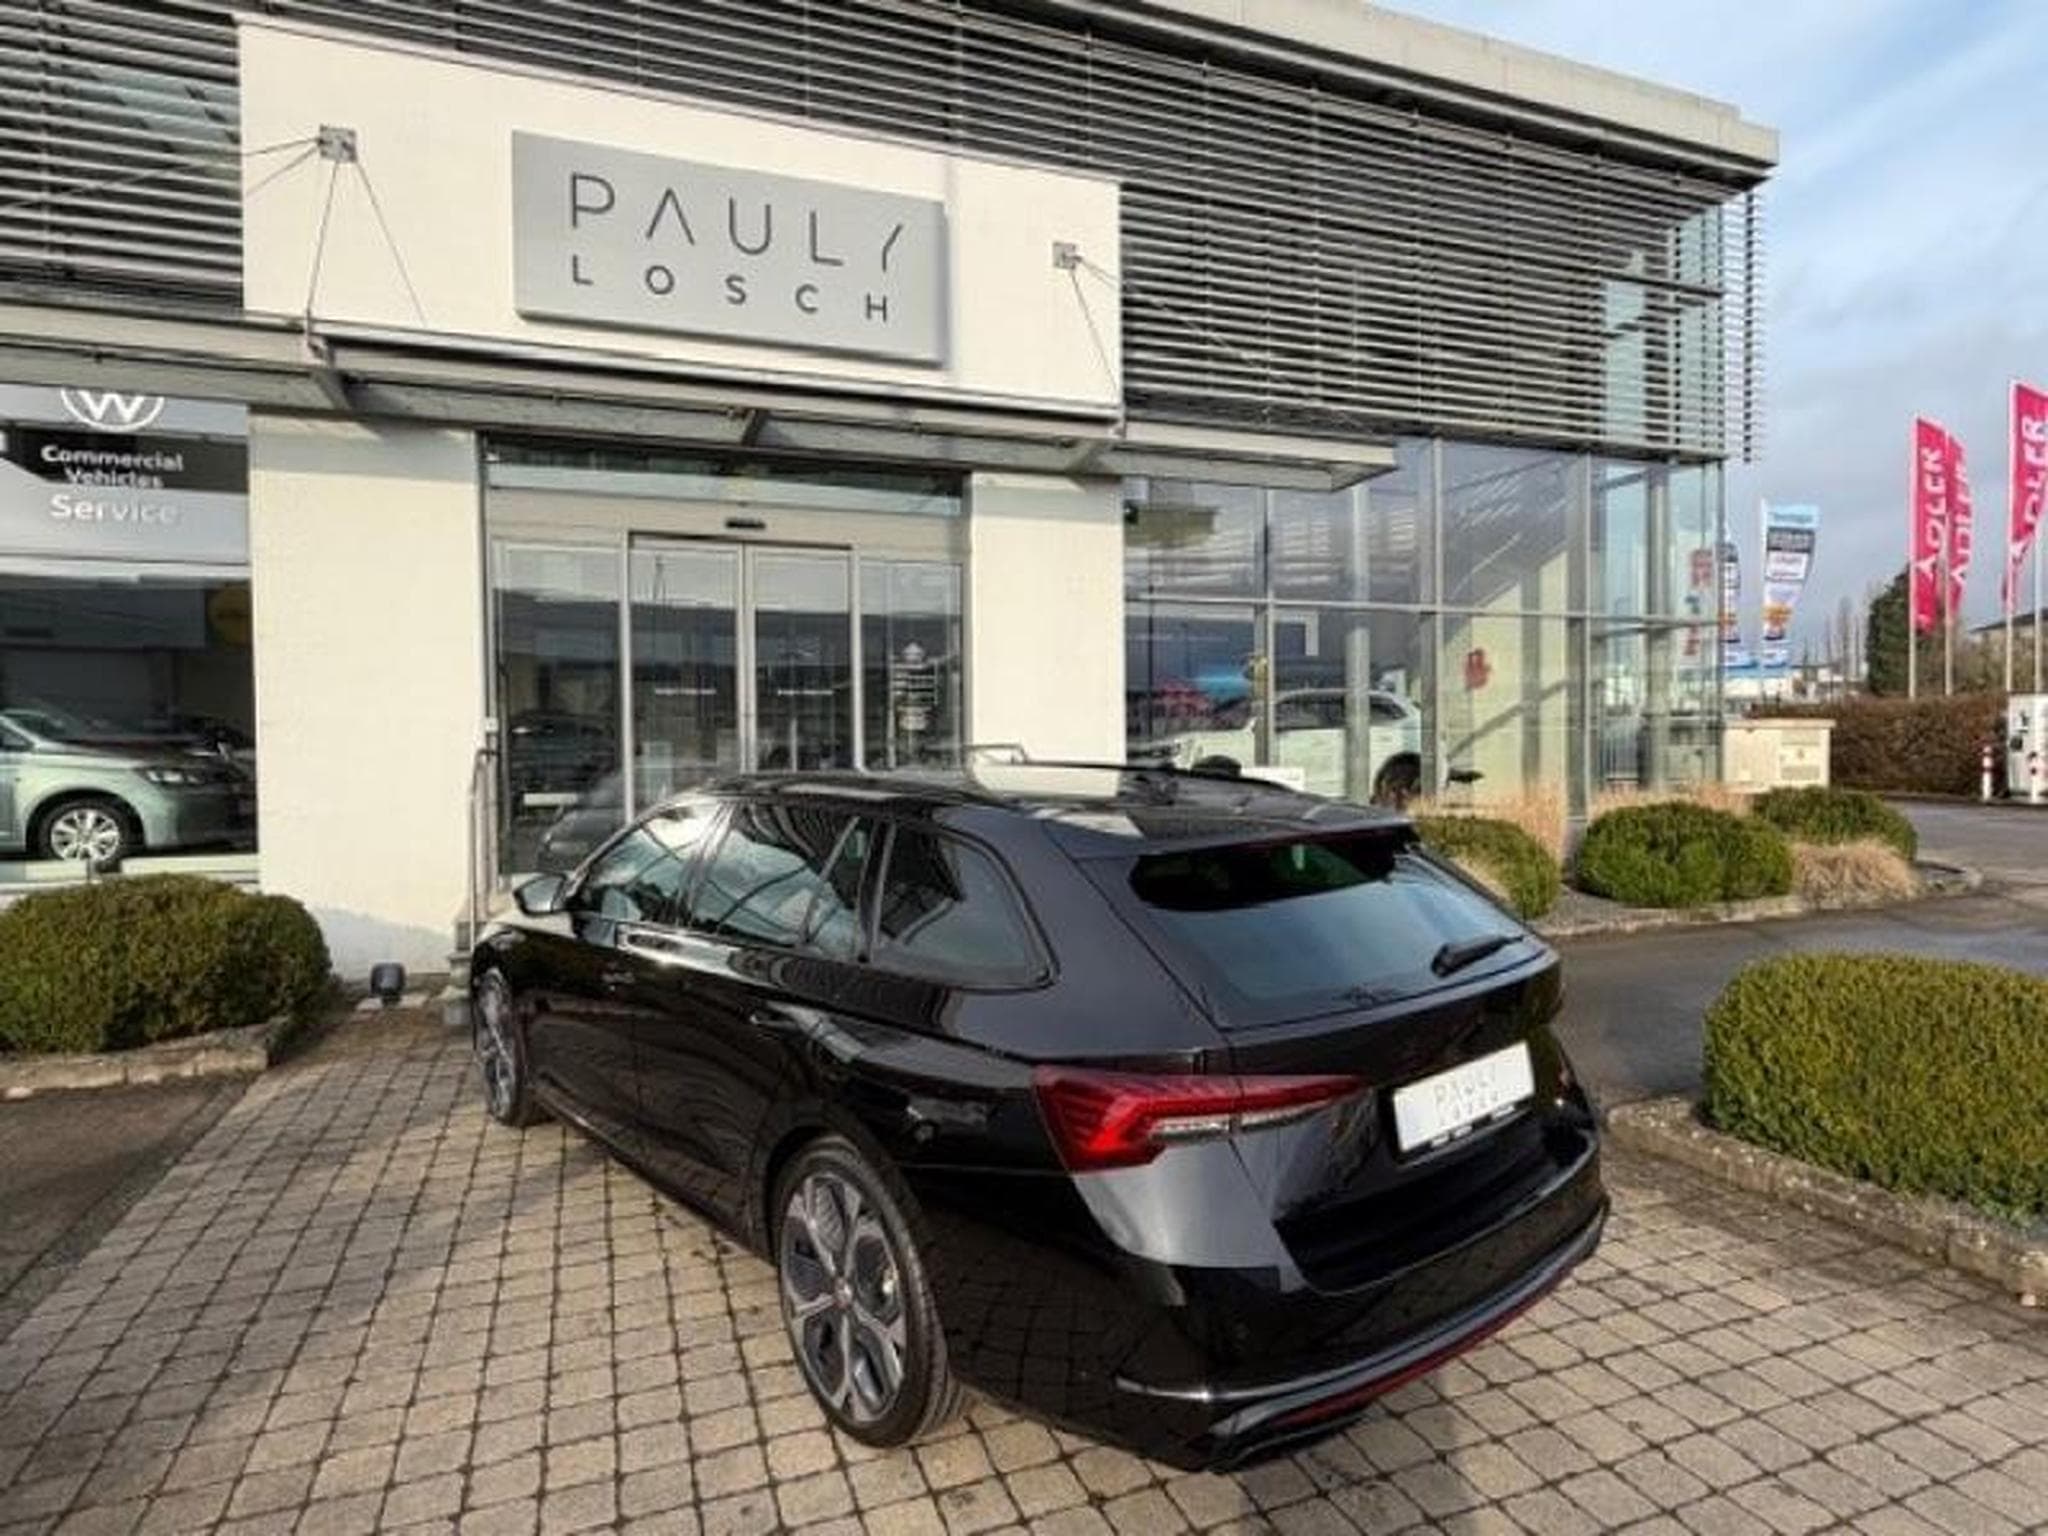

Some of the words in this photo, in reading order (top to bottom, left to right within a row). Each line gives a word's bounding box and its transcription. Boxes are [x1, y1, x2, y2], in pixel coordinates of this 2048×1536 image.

[570, 172, 904, 272] PAULY
[571, 254, 889, 323] LOSCH
[40, 444, 184, 472] Commercial
